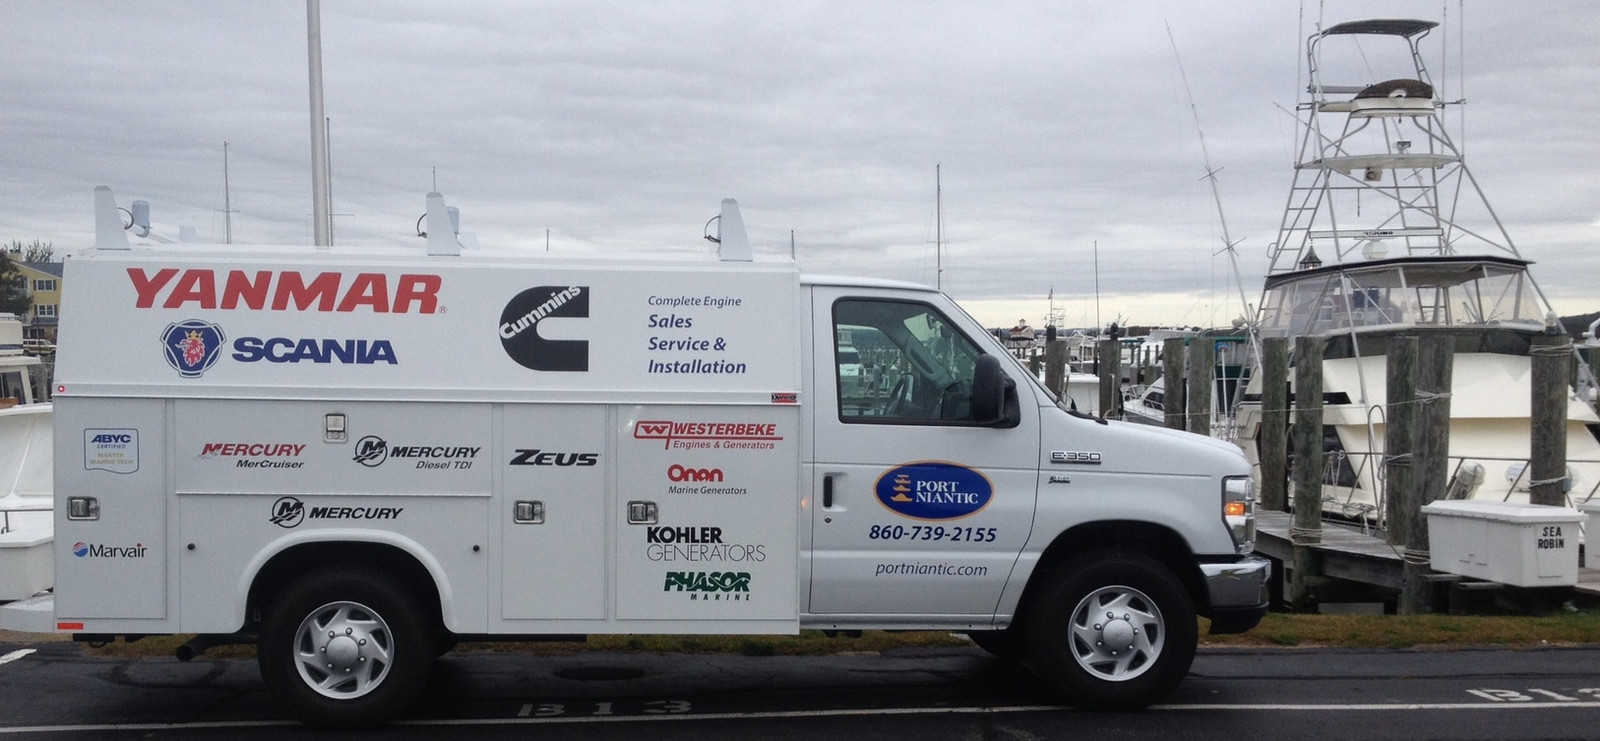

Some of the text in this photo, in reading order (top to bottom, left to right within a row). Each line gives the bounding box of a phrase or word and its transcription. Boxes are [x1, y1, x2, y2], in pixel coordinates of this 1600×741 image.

[127, 268, 442, 314] YANMAR
[648, 295, 742, 309] Complete Engine
[499, 284, 582, 341] Cummins
[648, 313, 693, 329] Sales
[232, 336, 398, 365] SCANIA
[648, 336, 727, 351] Service &
[648, 358, 747, 374] Installation
[674, 422, 777, 436] WESTERBEKE
[91, 434, 132, 443] ABYC
[673, 440, 775, 450] Engines & Generators
[201, 442, 307, 457] MERCURY
[390, 446, 481, 458] MERCURY
[236, 459, 305, 469] MerCruiser
[416, 460, 472, 469] Diesel TDI
[510, 449, 598, 466] ZEUS
[667, 464, 724, 482] Onan
[668, 486, 748, 495] Marine Generators
[916, 481, 959, 492] PORT
[915, 492, 978, 504] NIANTIC
[309, 507, 404, 519] MERCURY
[647, 526, 723, 544] KOHLER
[869, 525, 997, 543] 860-739-2155
[1542, 526, 1561, 537] SEA
[88, 543, 147, 558] Marvair
[1537, 537, 1565, 549] ROBIN
[646, 544, 766, 562] GENERATORS
[875, 561, 988, 577] portniantic.com
[664, 571, 752, 592] PHASOR
[690, 593, 751, 601] MARINE
